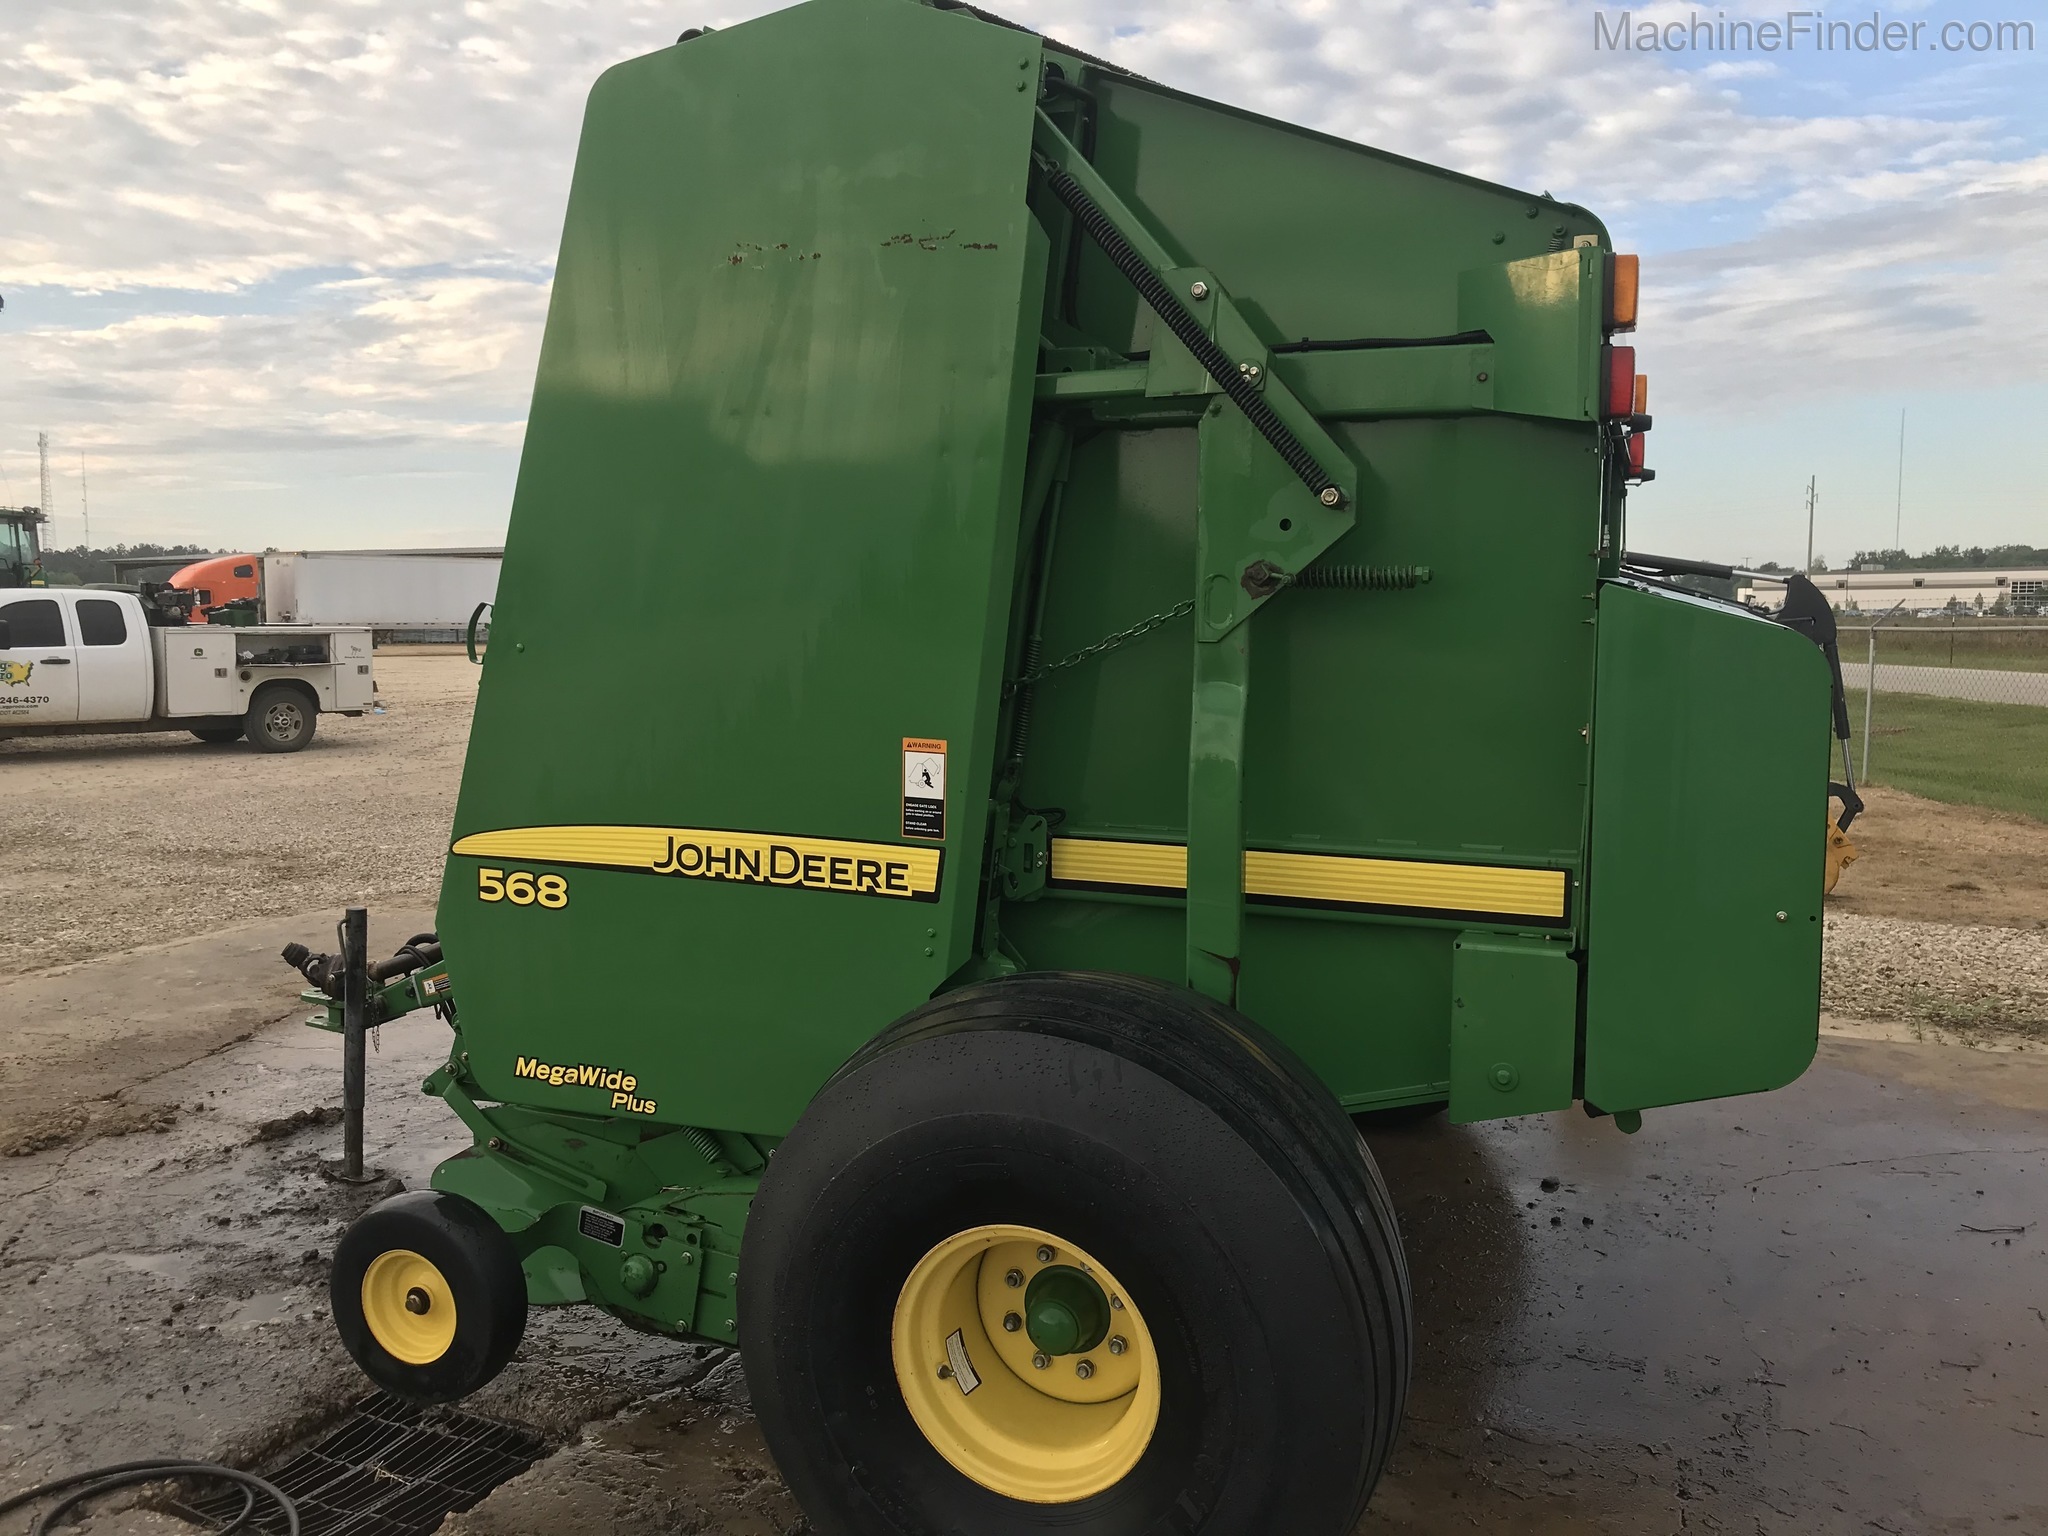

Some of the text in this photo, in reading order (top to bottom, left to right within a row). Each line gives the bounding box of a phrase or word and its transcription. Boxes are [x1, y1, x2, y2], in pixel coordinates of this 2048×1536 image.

[0, 696, 50, 704] 246-4370
[911, 741, 942, 750] WARNING
[653, 836, 910, 893] JOHN DEERE
[478, 867, 568, 908] 568
[515, 1055, 637, 1092] MegaWide
[611, 1092, 657, 1114] Plus
